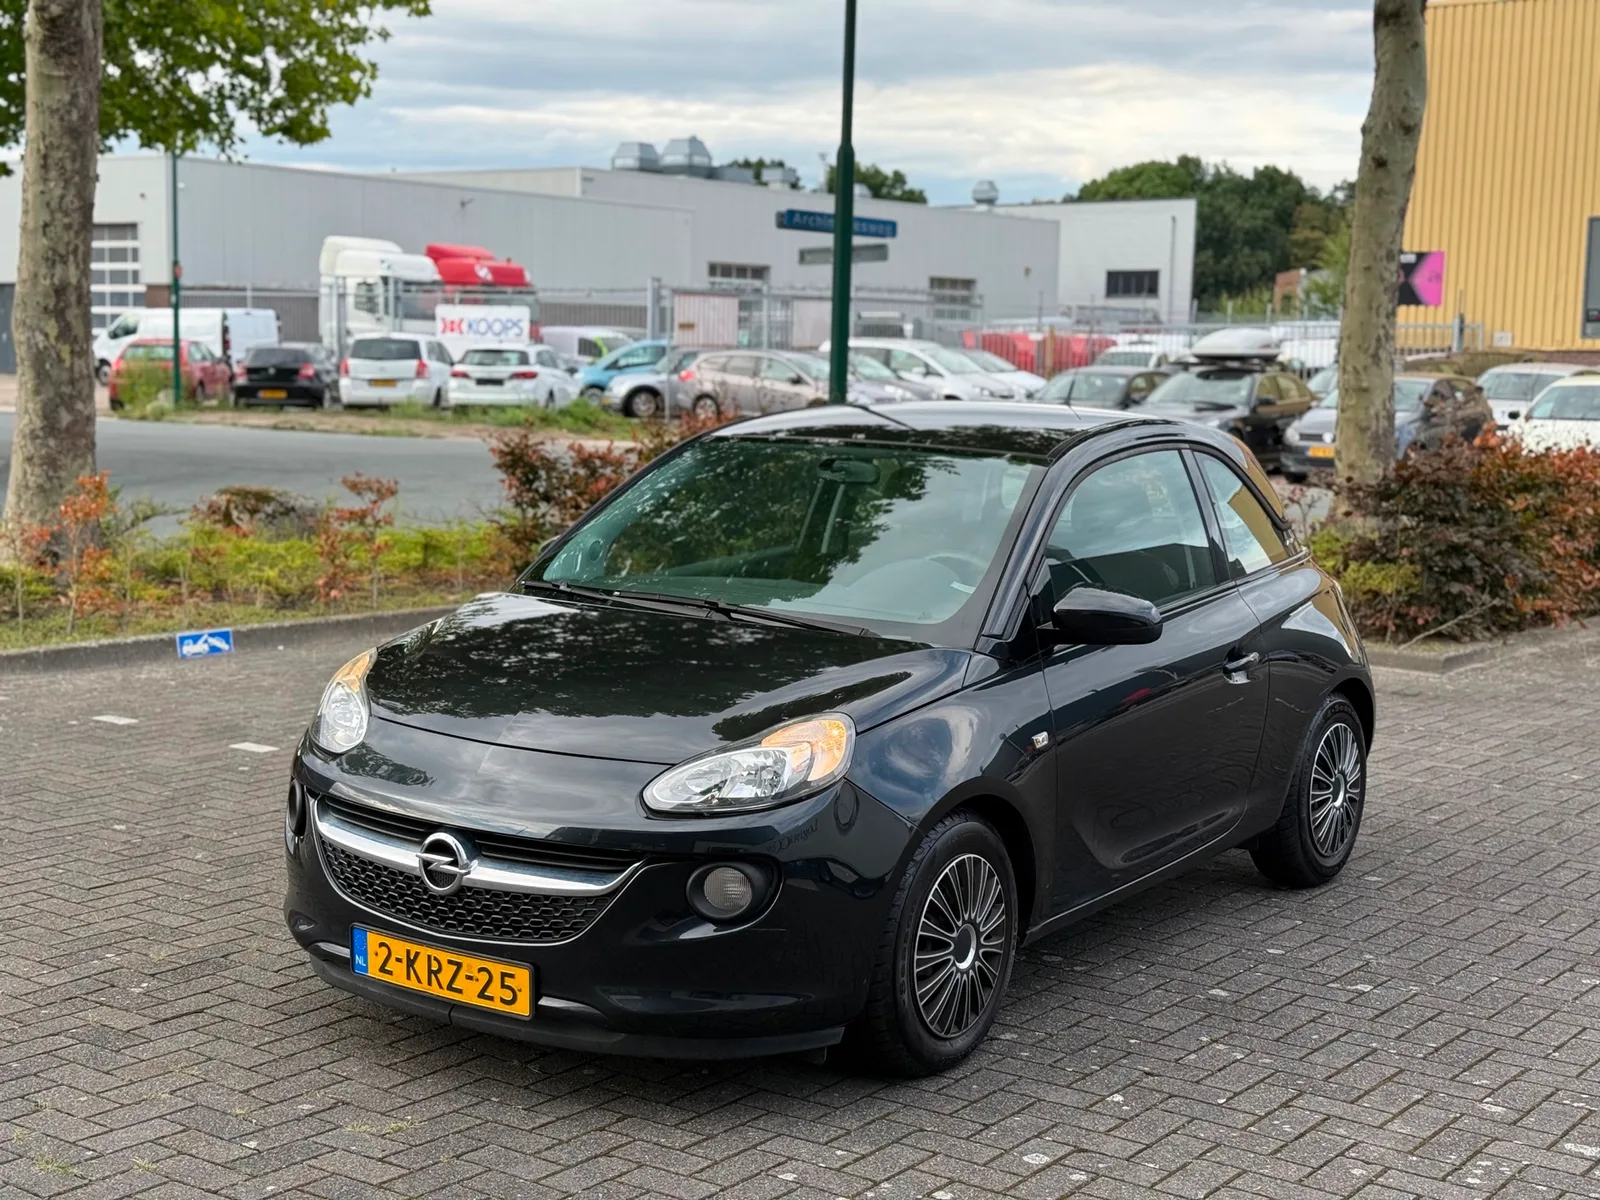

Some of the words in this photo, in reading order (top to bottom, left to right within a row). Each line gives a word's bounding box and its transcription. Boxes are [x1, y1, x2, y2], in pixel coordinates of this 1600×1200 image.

[467, 318, 523, 337] KOOPS
[355, 955, 367, 967] NL
[378, 941, 518, 1006] 2-KRZ-25
